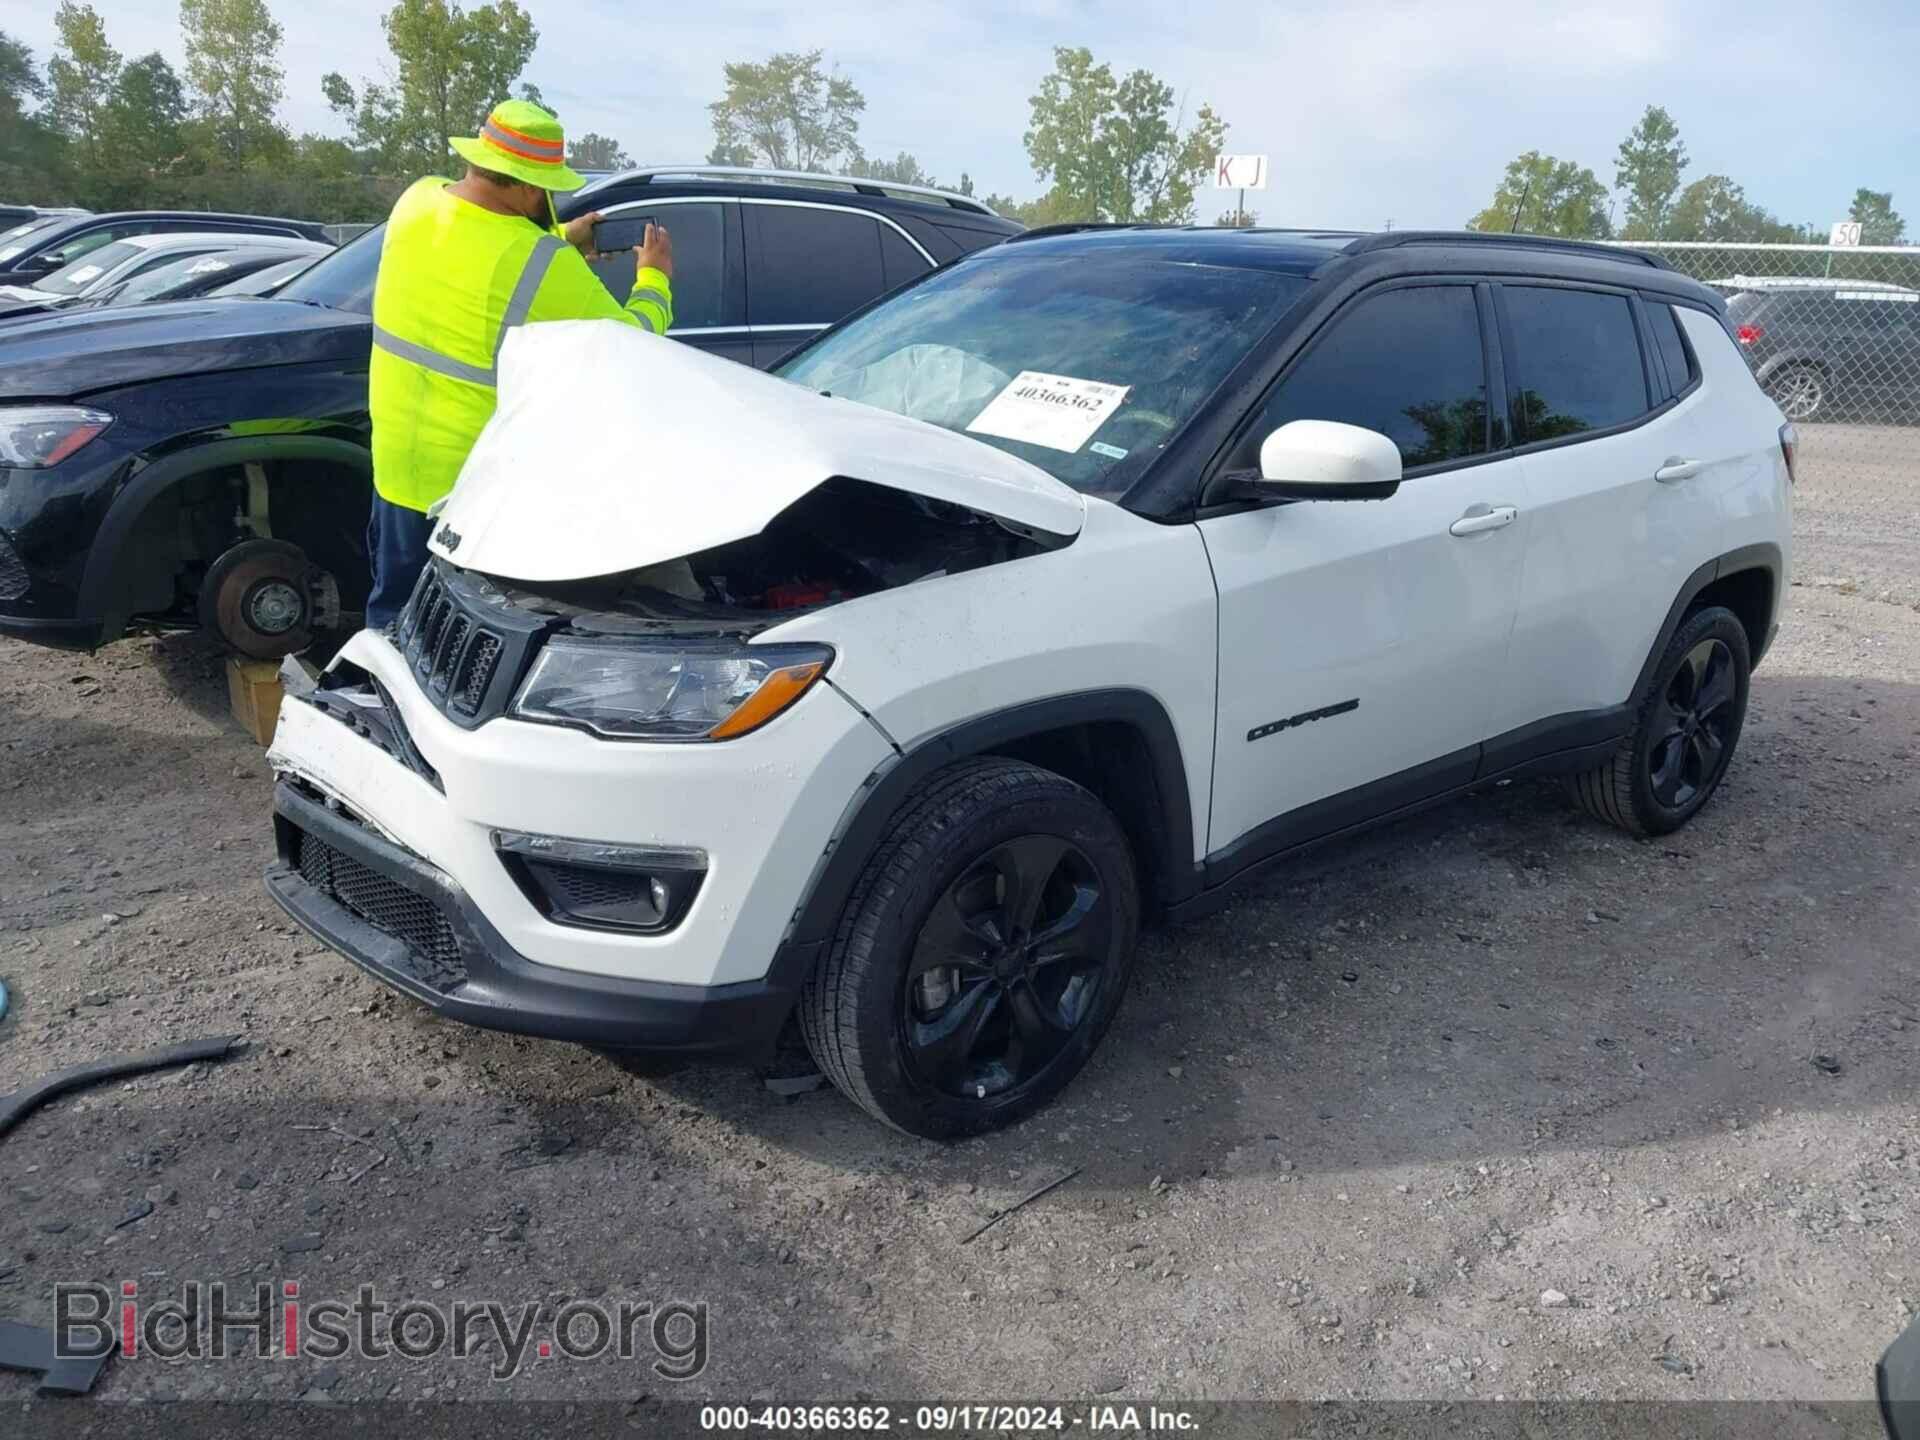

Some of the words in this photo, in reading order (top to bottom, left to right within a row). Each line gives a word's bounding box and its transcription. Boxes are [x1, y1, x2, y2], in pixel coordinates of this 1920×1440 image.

[1218, 157, 1232, 187] K
[1249, 157, 1261, 187] J
[1835, 223, 1860, 245] 50
[1014, 386, 1103, 412] 40366362
